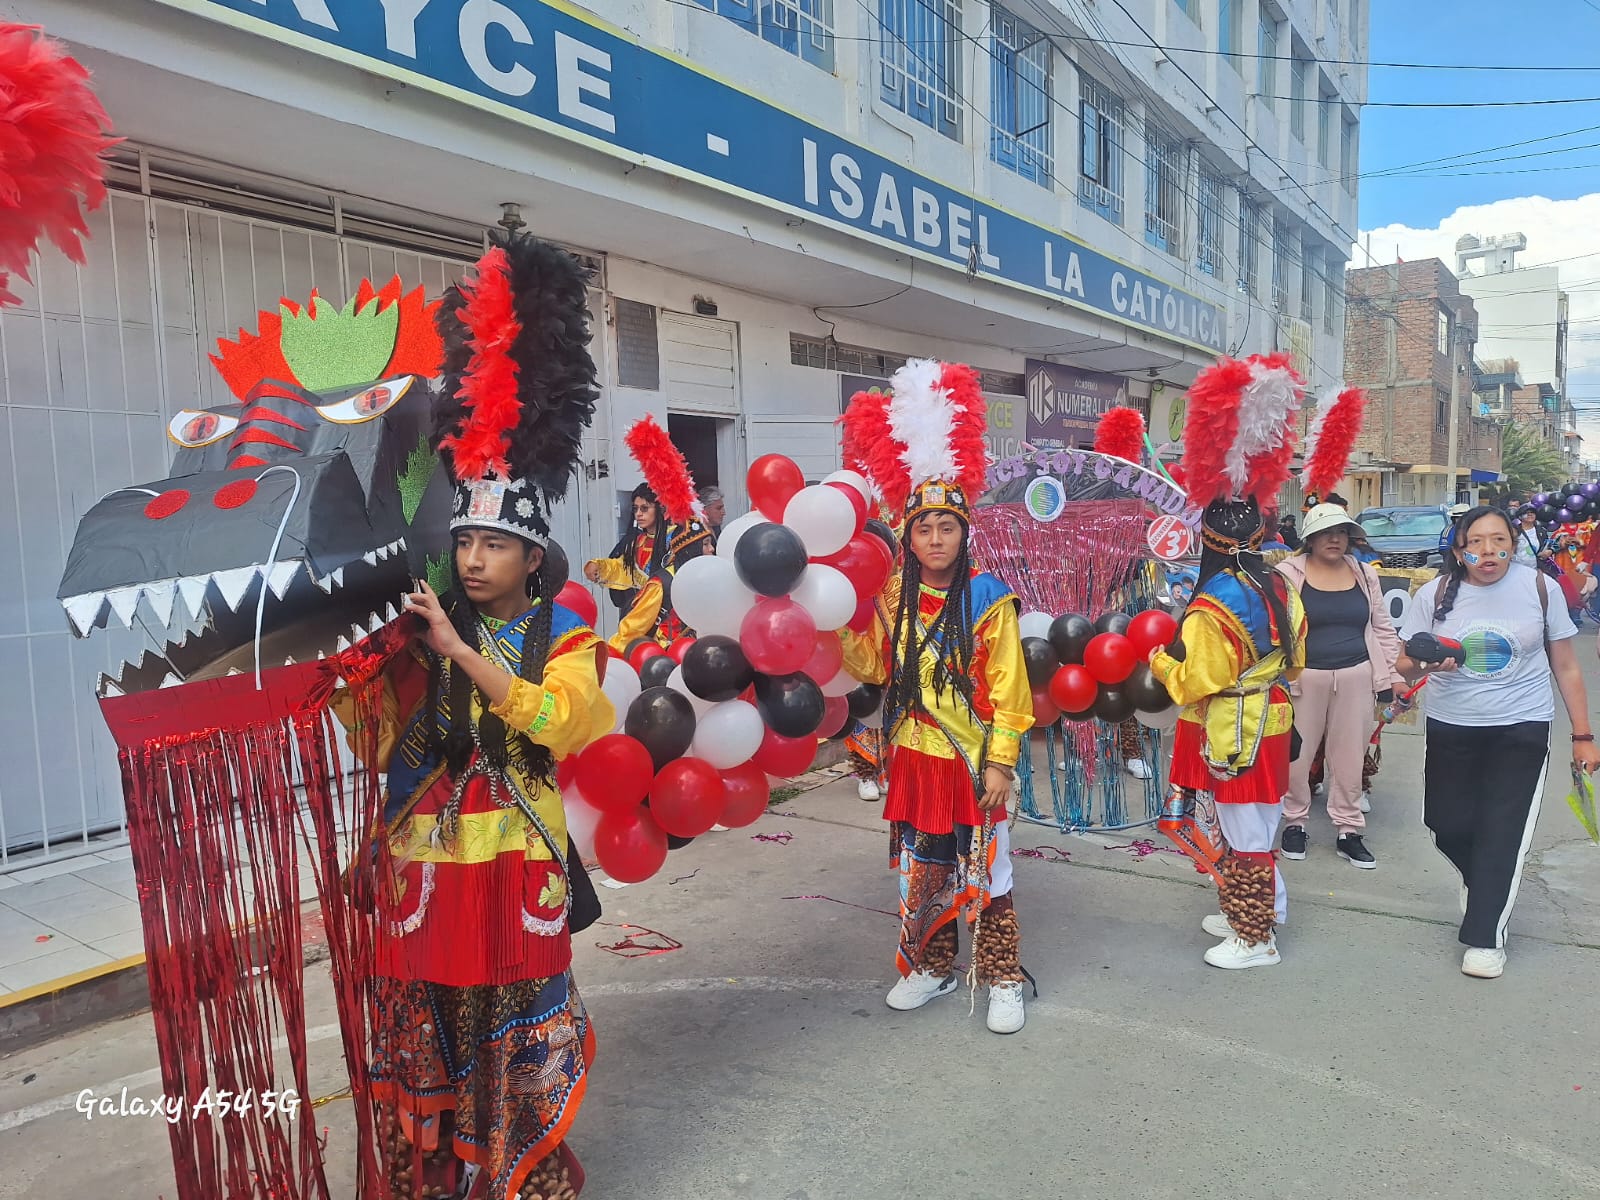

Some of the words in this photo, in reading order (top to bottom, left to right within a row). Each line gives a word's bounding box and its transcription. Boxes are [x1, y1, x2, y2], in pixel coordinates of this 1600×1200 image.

[802, 137, 1000, 269] ISABEL
[1043, 240, 1084, 298] LA
[1110, 271, 1221, 345] CATÓLICA
[1057, 391, 1102, 418] NUMERAL
[1094, 455, 1202, 532] GANADO
